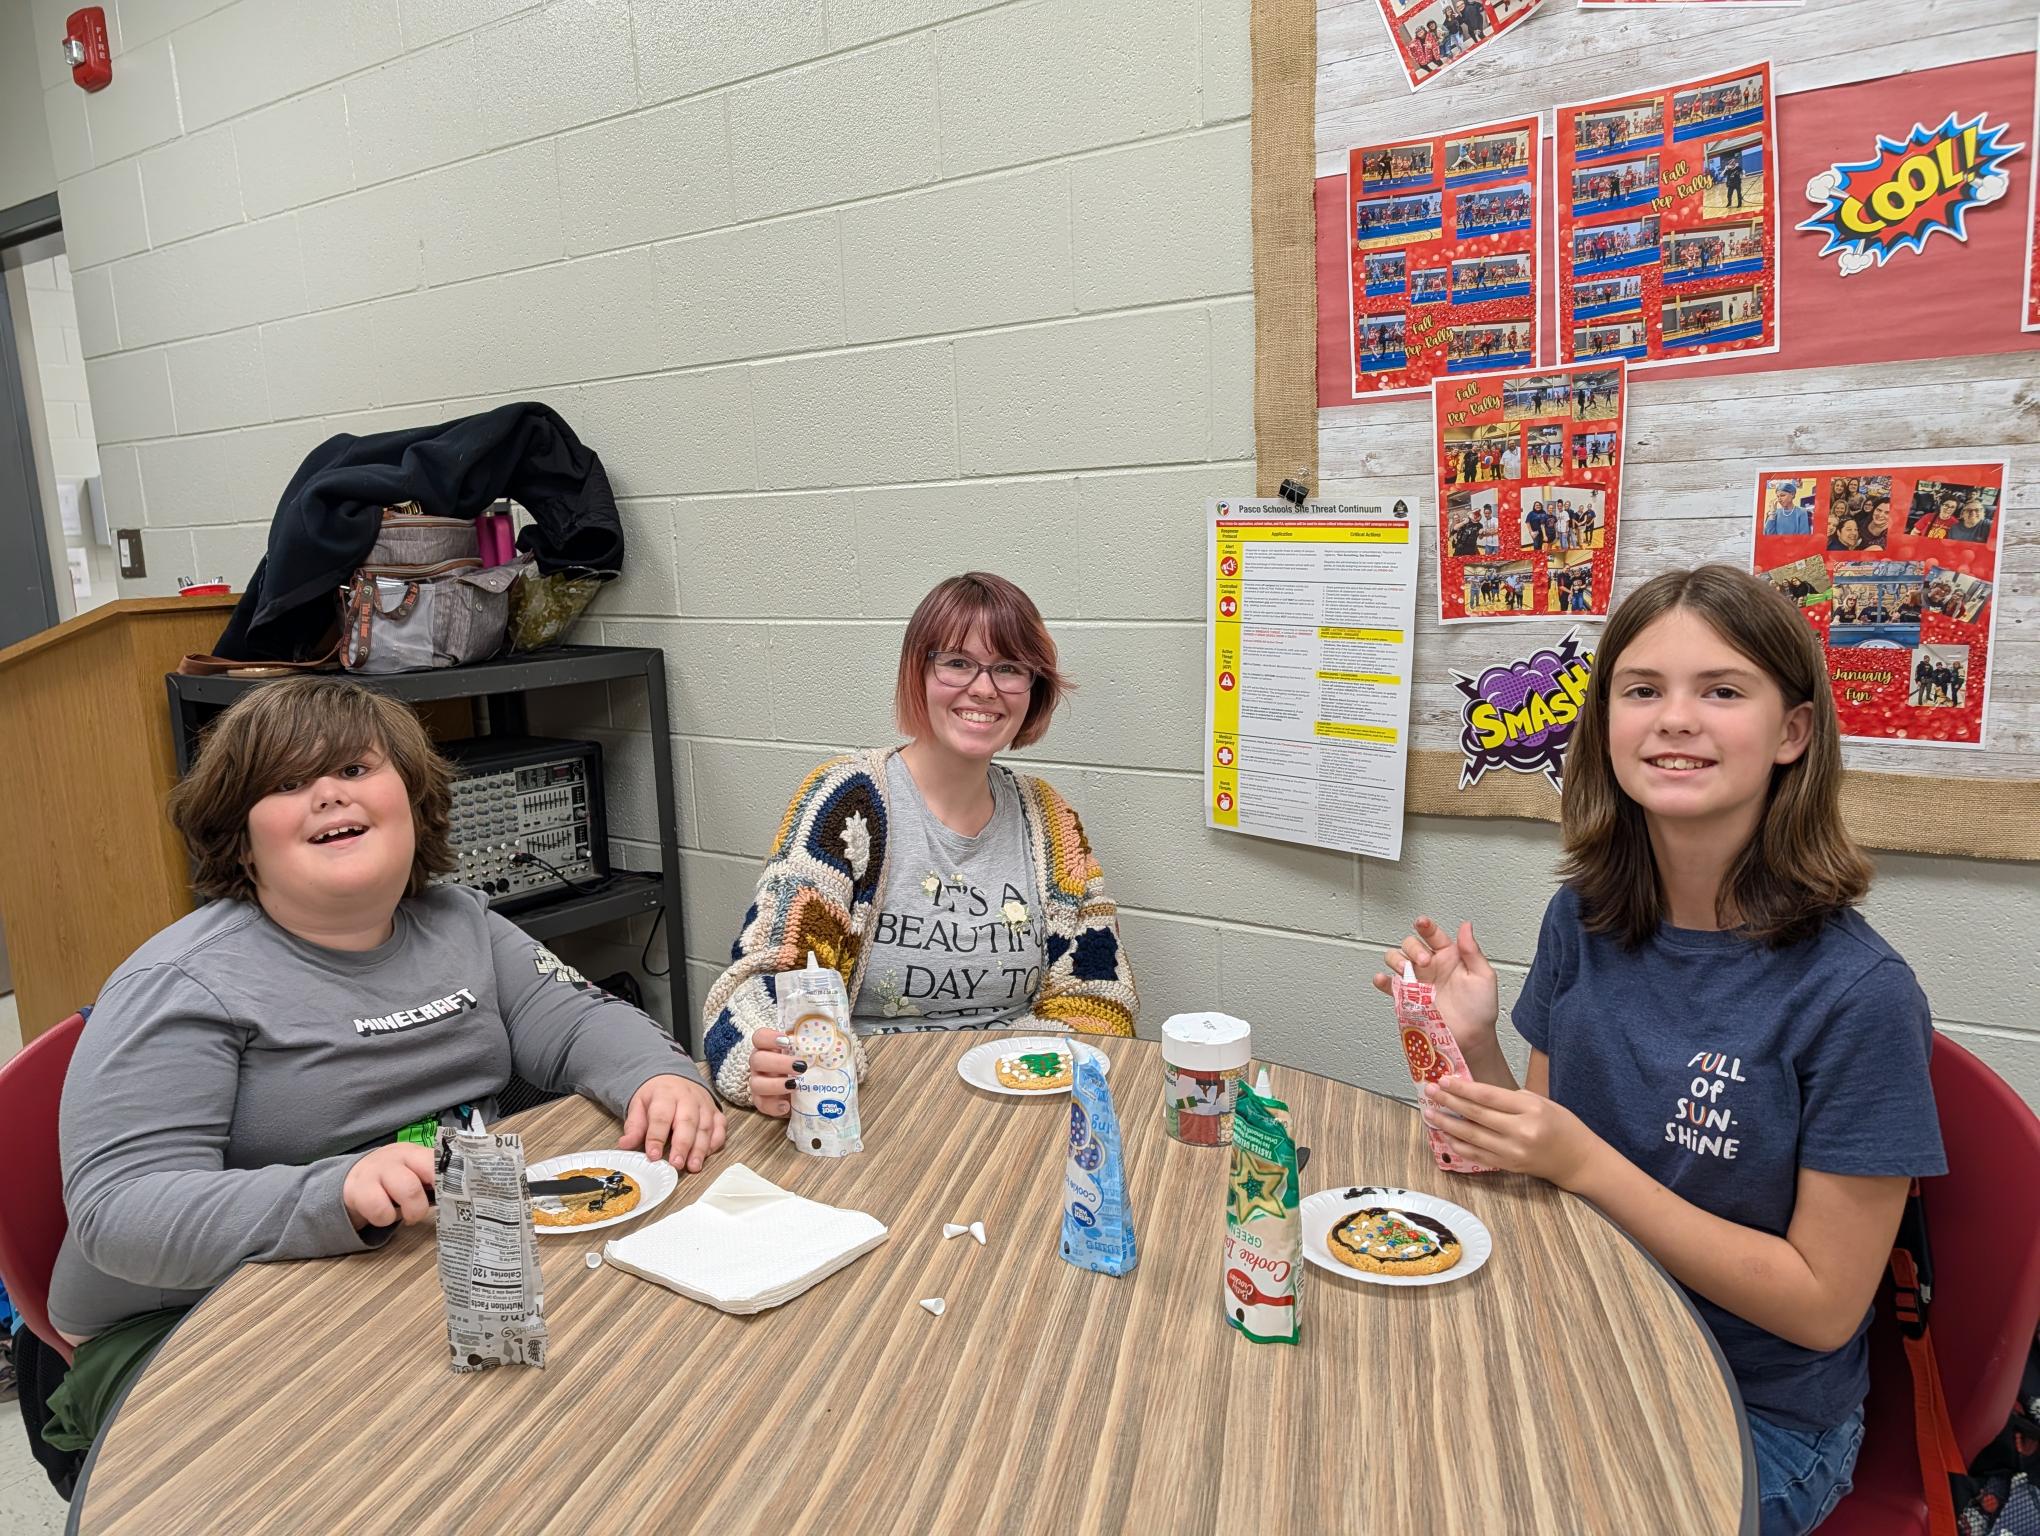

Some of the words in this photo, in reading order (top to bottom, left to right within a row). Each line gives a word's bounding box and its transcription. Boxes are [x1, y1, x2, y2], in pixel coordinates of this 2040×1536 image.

[95, 26, 106, 59] FIRE
[1662, 160, 1689, 185] Fall
[1840, 125, 1978, 233] COOL!
[1677, 174, 1714, 199] Rally
[1412, 314, 1434, 335] Fall
[1424, 327, 1455, 349] Rally
[1456, 381, 1480, 402] Fall
[1469, 395, 1502, 416] Rally
[1238, 504, 1261, 514] Pasco
[1262, 504, 1292, 514] Schools
[1294, 503, 1309, 514] Site
[1311, 504, 1337, 514] Threat
[1338, 504, 1382, 514] Continuum
[1831, 667, 1893, 685] January
[1845, 687, 1872, 702] Fun
[932, 878, 989, 917] IT'S
[1001, 882, 1028, 908] A
[873, 912, 1044, 953] BEAUTIFU
[902, 964, 989, 1000] DAY
[1001, 966, 1040, 999] TO
[353, 987, 477, 1036] MINECRAFT
[1687, 1051, 1746, 1082] FULL
[812, 1085, 845, 1094] Cookie
[821, 1107, 843, 1115] Great
[1675, 1097, 1739, 1132] SUN-
[1251, 1143, 1273, 1159] TASTES
[1069, 1182, 1096, 1203] Cookie
[1230, 1222, 1263, 1249] GREEN
[472, 1267, 488, 1278] 120
[490, 1271, 522, 1279] Calories
[1239, 1248, 1291, 1283] Cookie
[1229, 1272, 1254, 1295] Crocker
[471, 1300, 489, 1310] Facts
[490, 1302, 523, 1311] Nutrition
